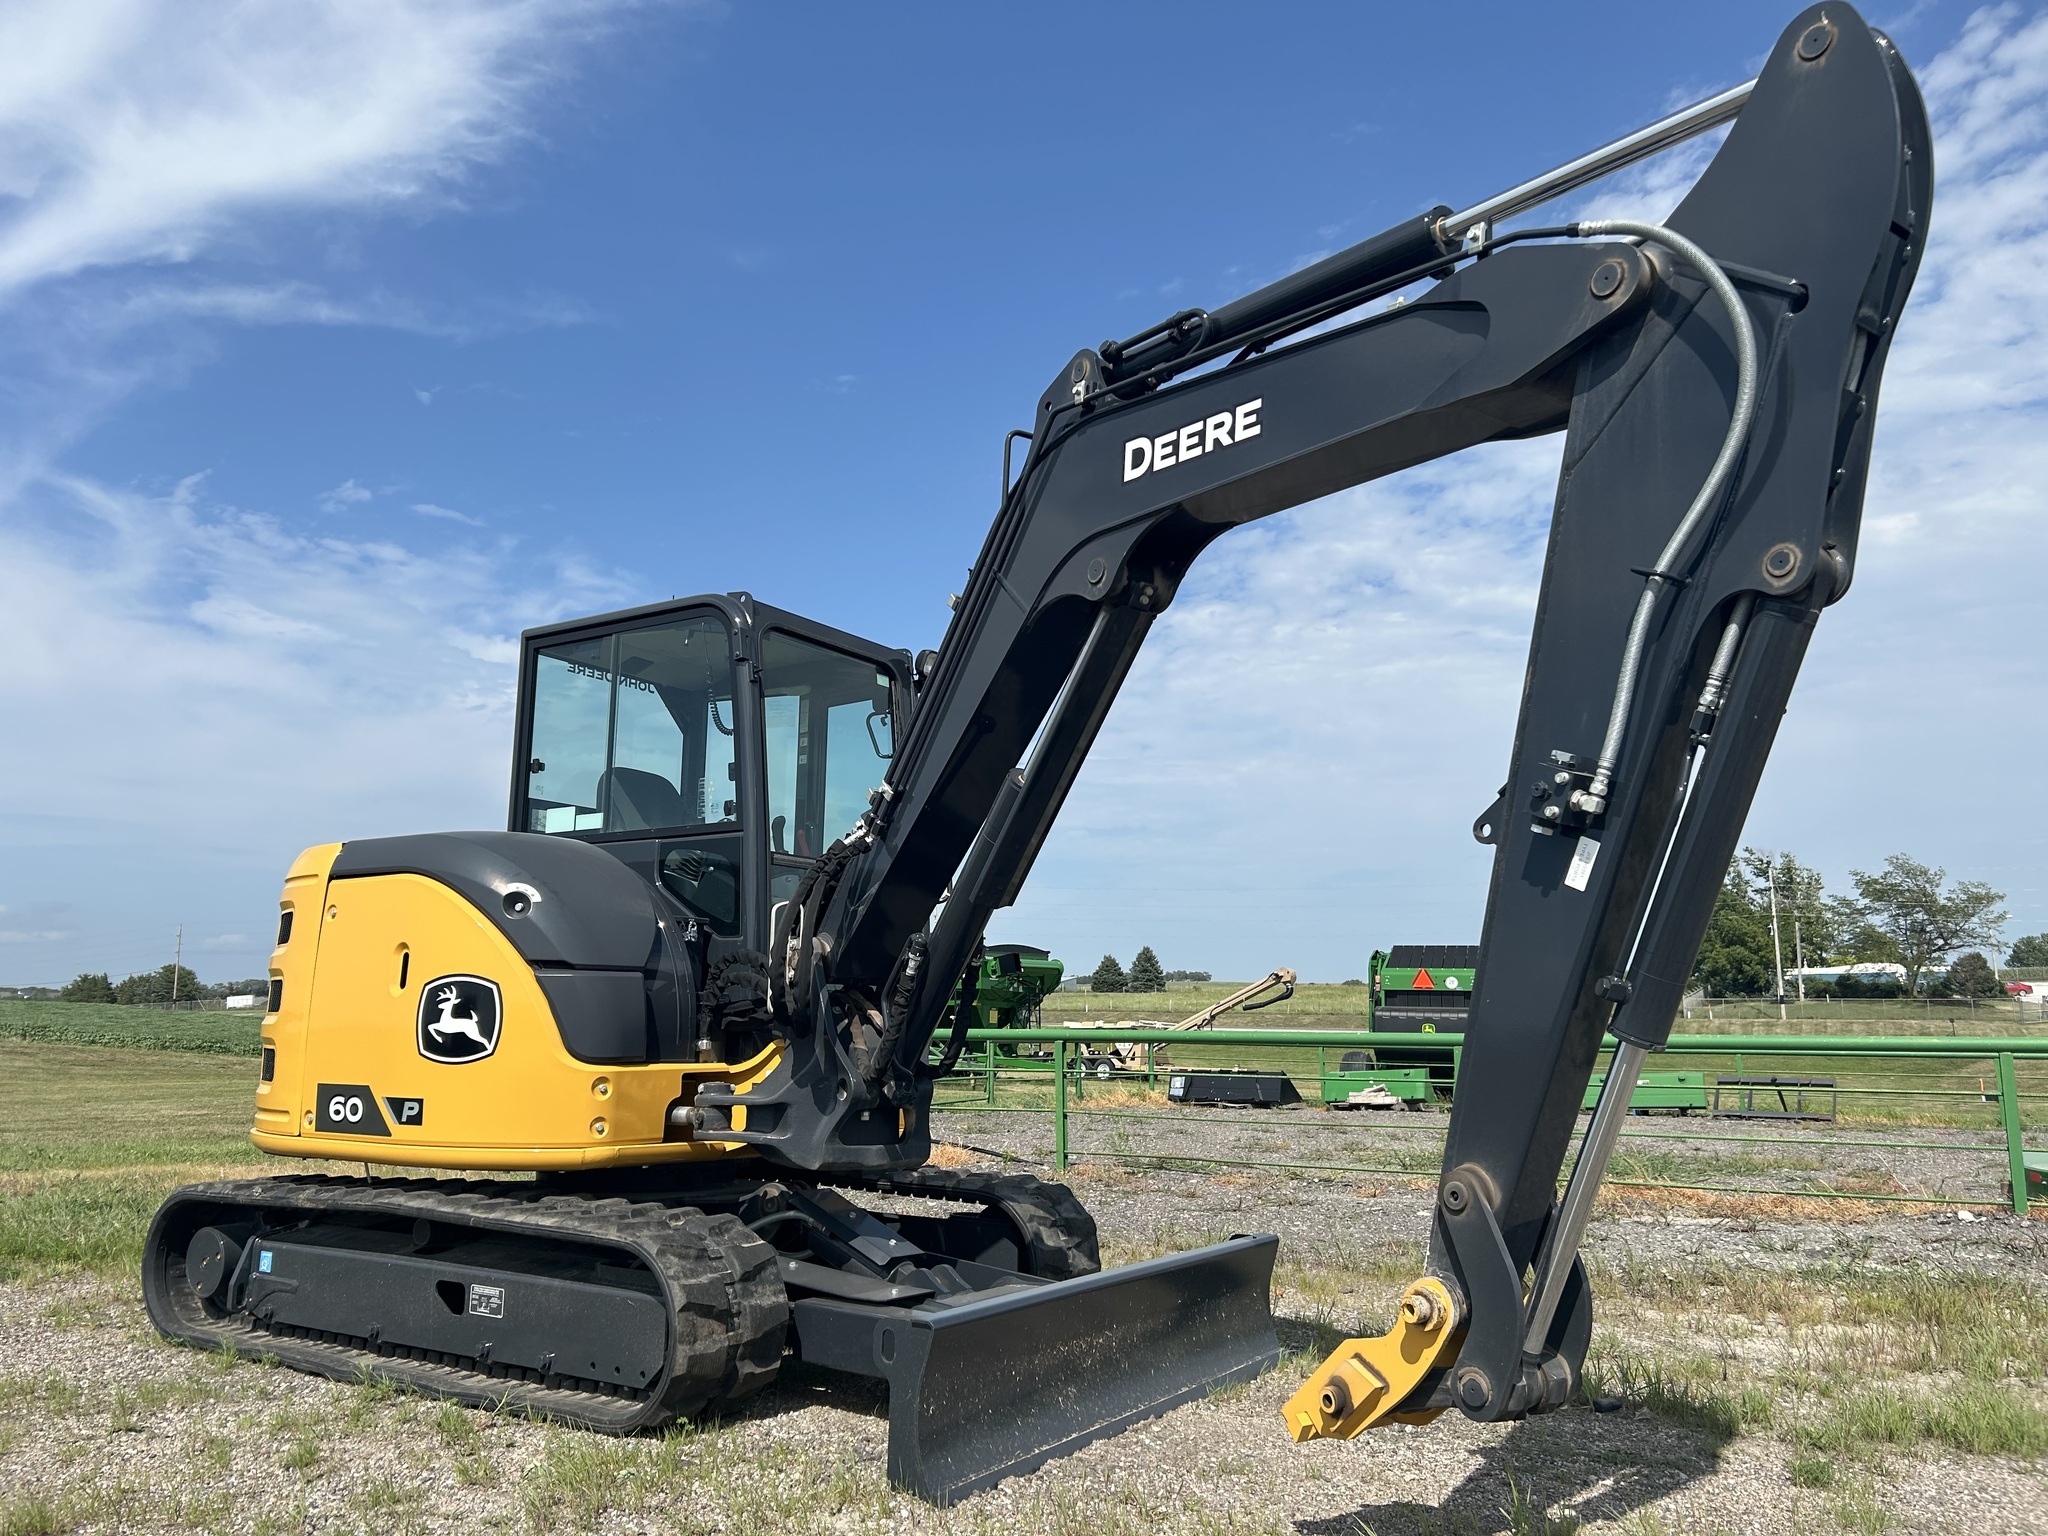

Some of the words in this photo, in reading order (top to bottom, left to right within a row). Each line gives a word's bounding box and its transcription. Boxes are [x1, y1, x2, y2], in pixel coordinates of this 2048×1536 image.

[1123, 397, 1262, 483] DEERE
[328, 1095, 364, 1123] 60
[401, 1101, 420, 1122] P
